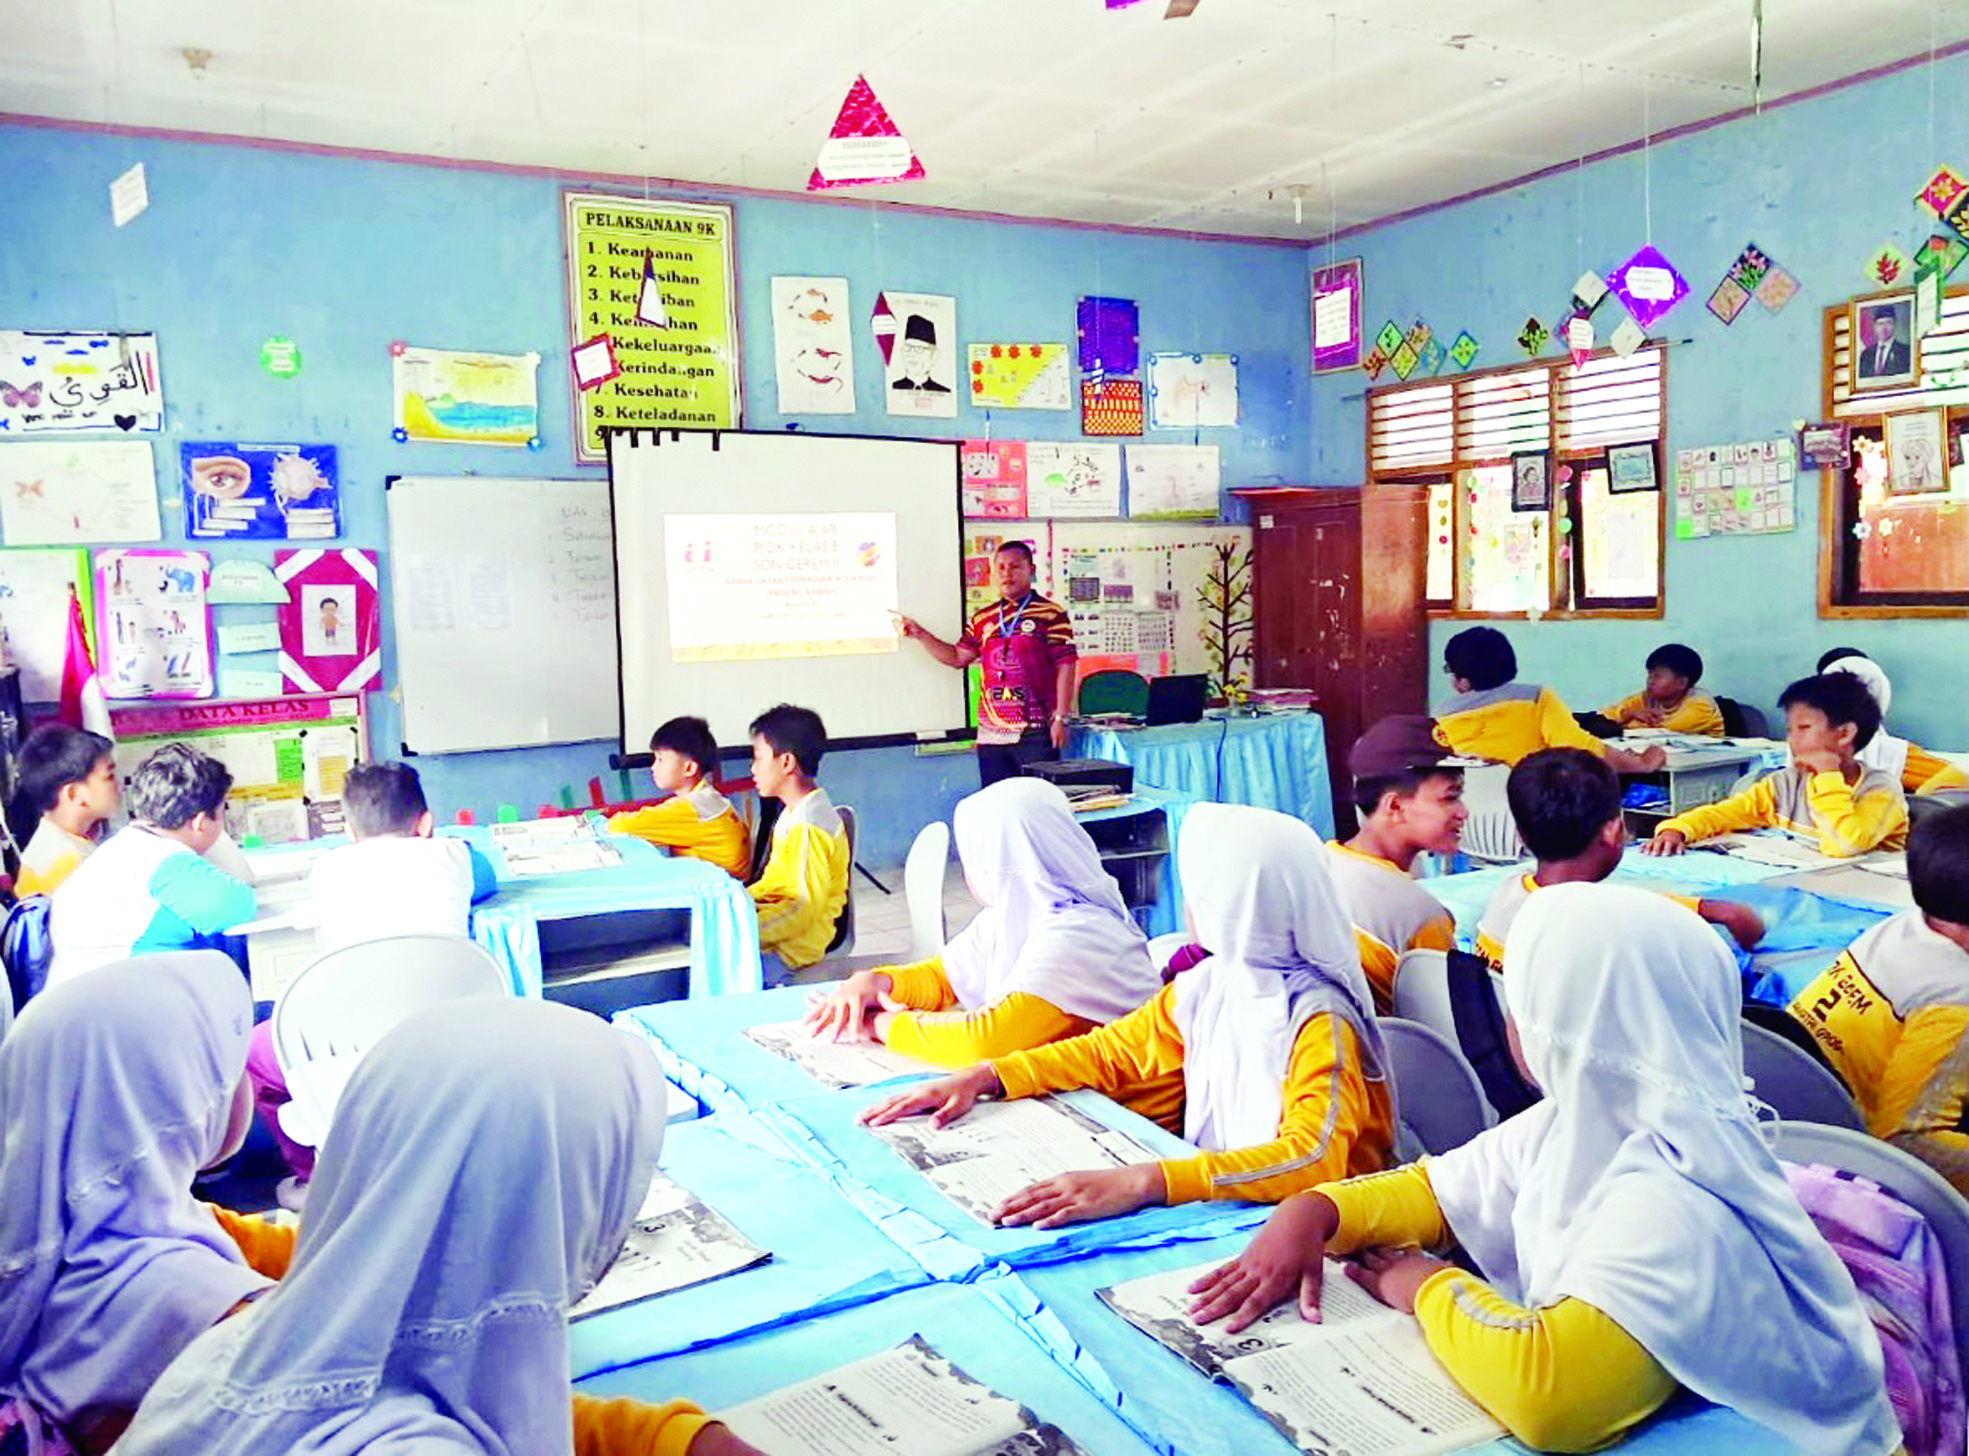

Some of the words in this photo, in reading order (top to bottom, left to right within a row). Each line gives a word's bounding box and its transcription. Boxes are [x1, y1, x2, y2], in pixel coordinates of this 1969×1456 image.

[585, 212, 692, 233] PELAKSANAAN
[697, 222, 716, 236] 9K
[609, 265, 699, 285] Kebsihan
[610, 289, 695, 307] Ketiban
[612, 336, 721, 356] Kekeluargaa
[616, 406, 716, 422] Keteladanan
[754, 523, 804, 537] MODUL
[808, 523, 838, 539] AJAR
[753, 541, 785, 557] PJOK
[790, 540, 828, 554] KELAS
[831, 539, 839, 552] 5
[753, 558, 782, 572] SDN
[785, 557, 829, 571] GEREM
[180, 705, 235, 721] DATA
[242, 699, 309, 717] KELAS
